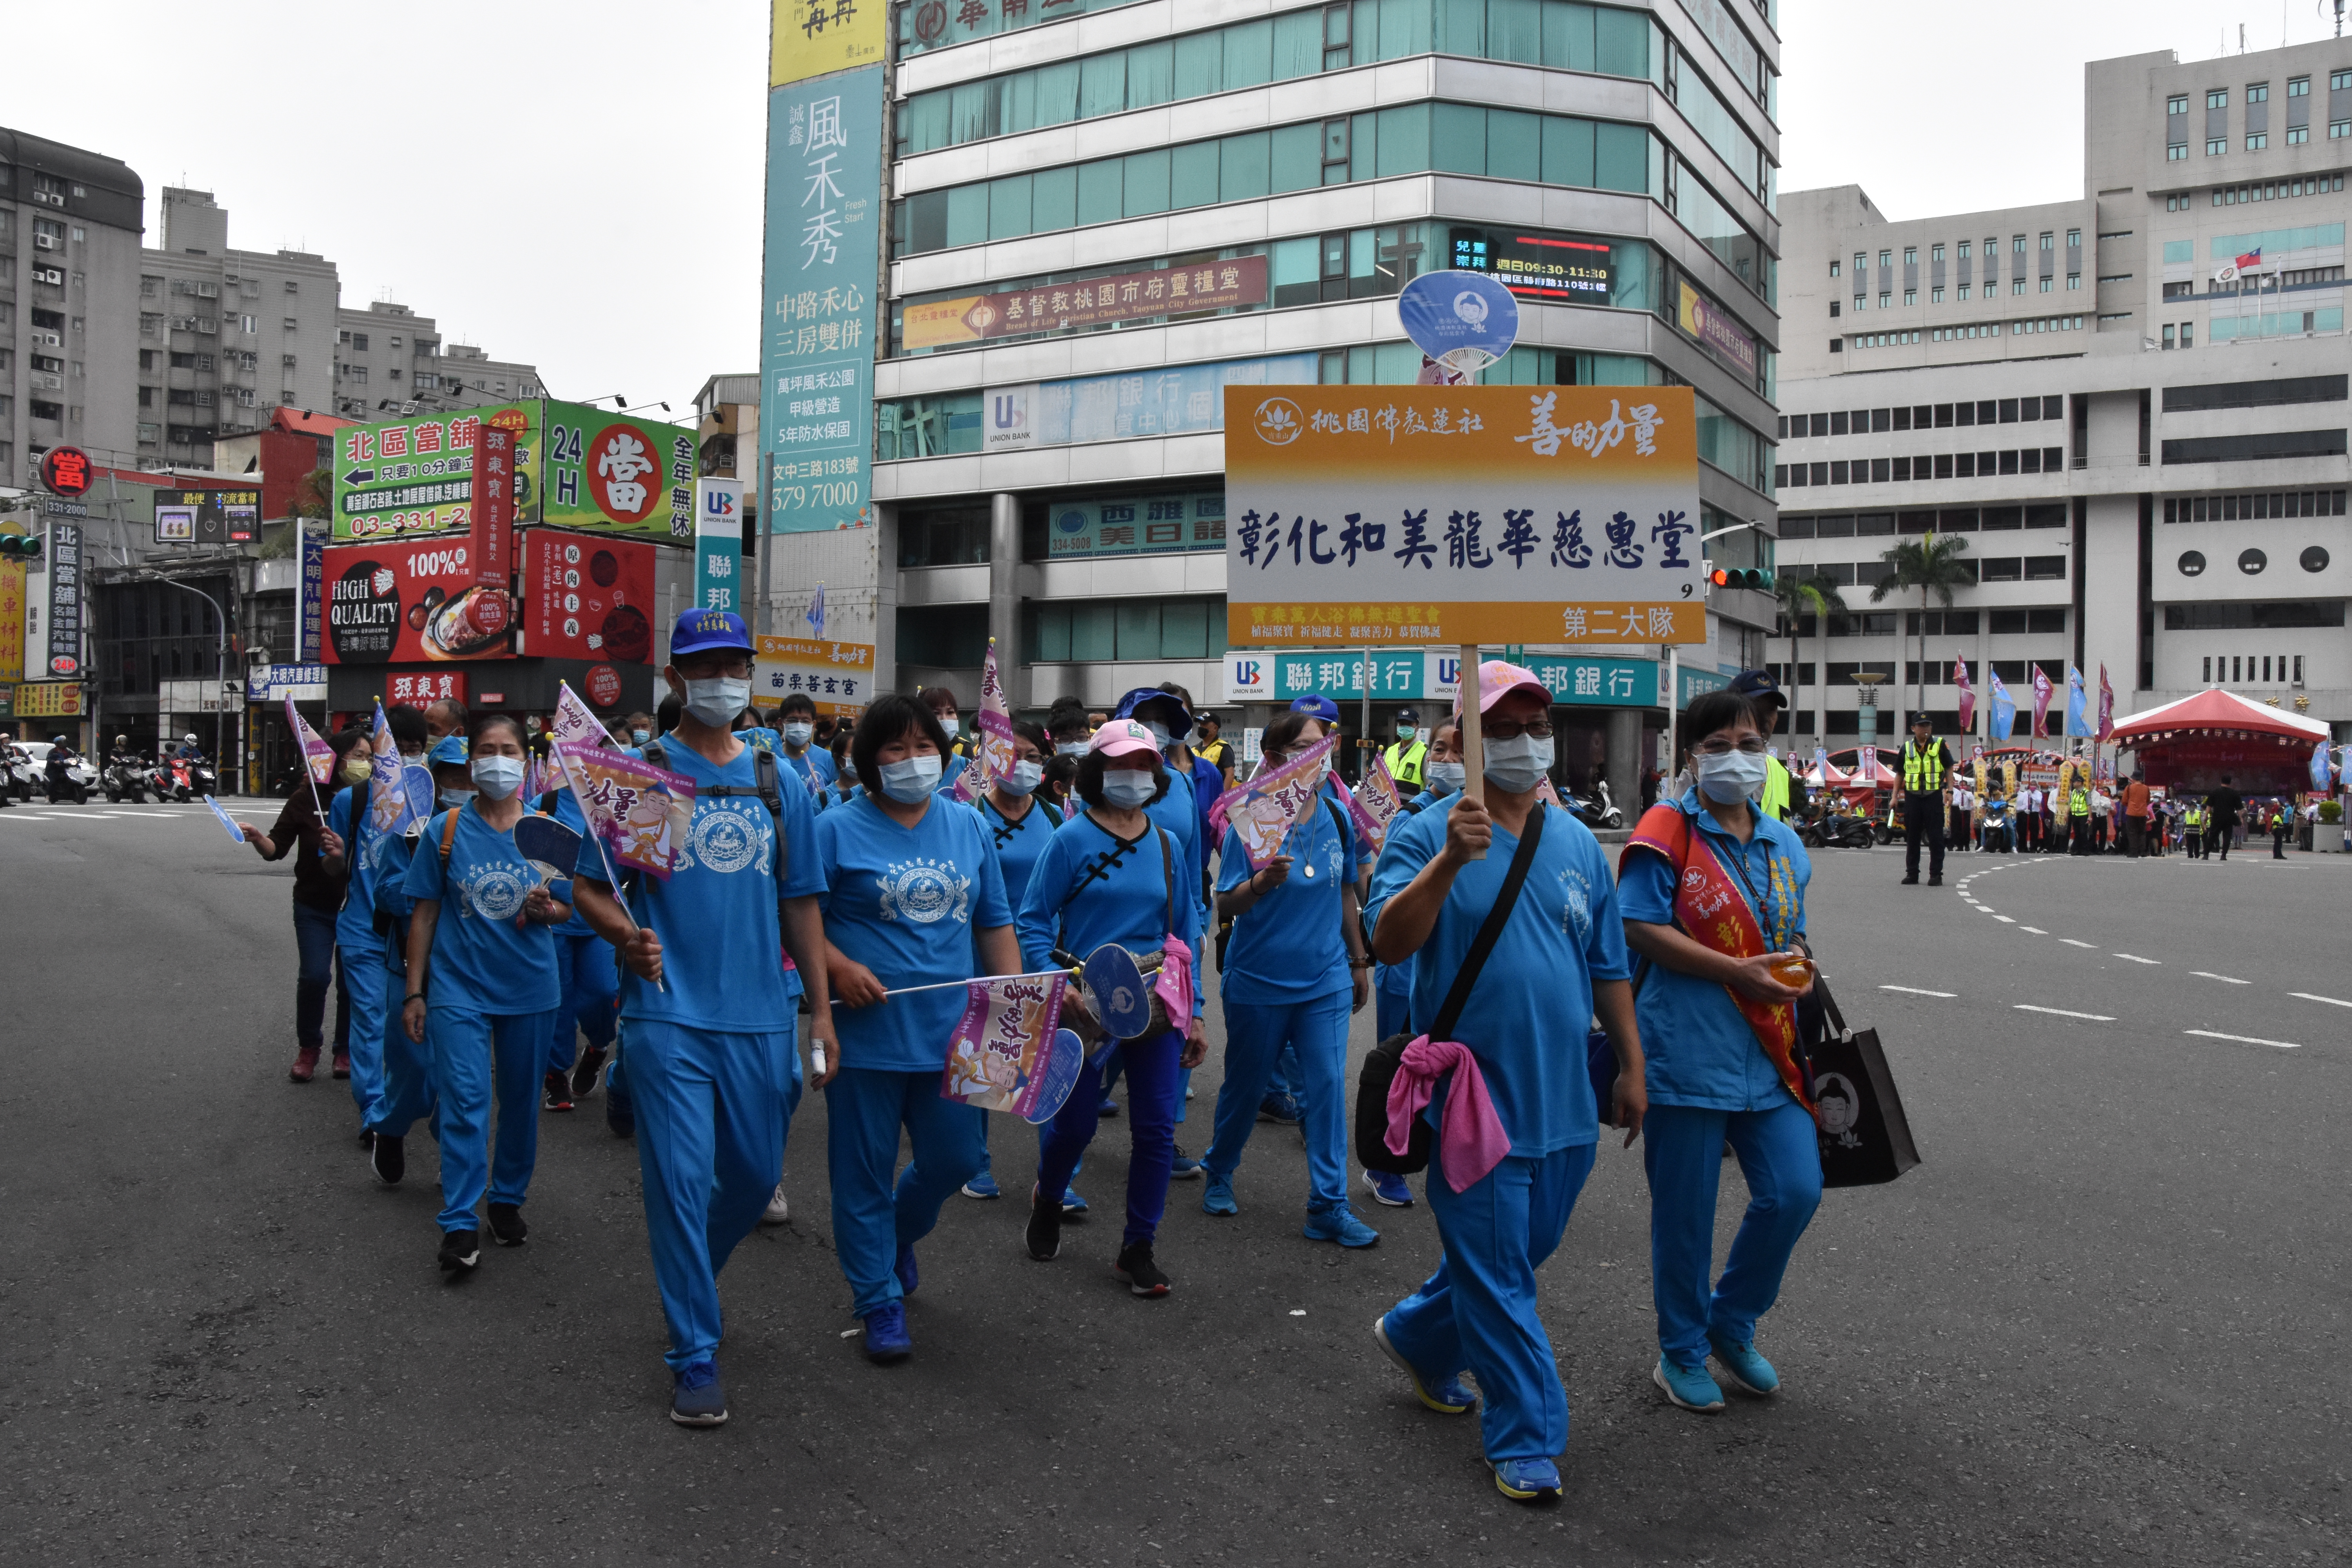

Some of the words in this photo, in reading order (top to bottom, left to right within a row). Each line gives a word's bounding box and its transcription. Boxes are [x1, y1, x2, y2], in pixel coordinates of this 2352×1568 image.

[789, 103, 804, 147] 誠鑫
[801, 95, 847, 271] 風禾秀
[844, 212, 864, 223] Start
[845, 199, 867, 210] Fresh
[775, 284, 864, 323] 中路禾心
[1006, 267, 1239, 320] 基督教桃園市府靈糧堂
[1006, 321, 1027, 330] Bread
[1041, 316, 1056, 326] Life
[1060, 312, 1095, 324] Christian
[1098, 308, 1128, 318] Church,
[1133, 303, 1164, 314] Taoyuan
[1168, 300, 1185, 310] City
[1189, 293, 1238, 305] Government
[774, 318, 863, 358] 三房雙併
[778, 369, 855, 395] 萬坪風禾公園
[491, 414, 524, 426] 24H
[789, 397, 840, 417] 甲級營造
[347, 415, 481, 464] 北區當舖
[779, 421, 851, 444] 5年防水保固
[990, 433, 1011, 442] UNION
[1012, 432, 1031, 441] BANK
[1514, 390, 1664, 459] 善的力量
[552, 427, 583, 464] 24
[53, 452, 86, 489] 當
[380, 448, 530, 483] 只要10分鐘立款
[598, 434, 652, 514] 當
[773, 456, 859, 481] 文中三路183號
[555, 468, 578, 507] H
[670, 435, 695, 537] 全年無休
[772, 485, 805, 511] 379
[812, 481, 858, 508] 7000
[49, 502, 87, 516] 331-2000
[1052, 537, 1091, 551] 334-5008
[1237, 508, 1695, 570] 彰化和美龍華慈惠堂
[55, 526, 76, 605] 北區當舖
[331, 579, 369, 601] HIGH
[566, 548, 579, 635] 原肉主義
[707, 554, 731, 610] 聯邦
[1681, 583, 1694, 599] 9
[331, 602, 398, 625] QUALITY
[480, 603, 500, 612] 100%
[1562, 606, 1675, 639] 第二大隊
[54, 658, 76, 671] 24H
[271, 666, 328, 684] 大明汽車修理廠
[595, 673, 615, 683] 100%
[1285, 661, 1412, 691] 聯邦銀行
[395, 674, 453, 699] 孫東寶
[1526, 665, 1634, 697] 邦銀行
[1696, 891, 1731, 920] 善的力量
